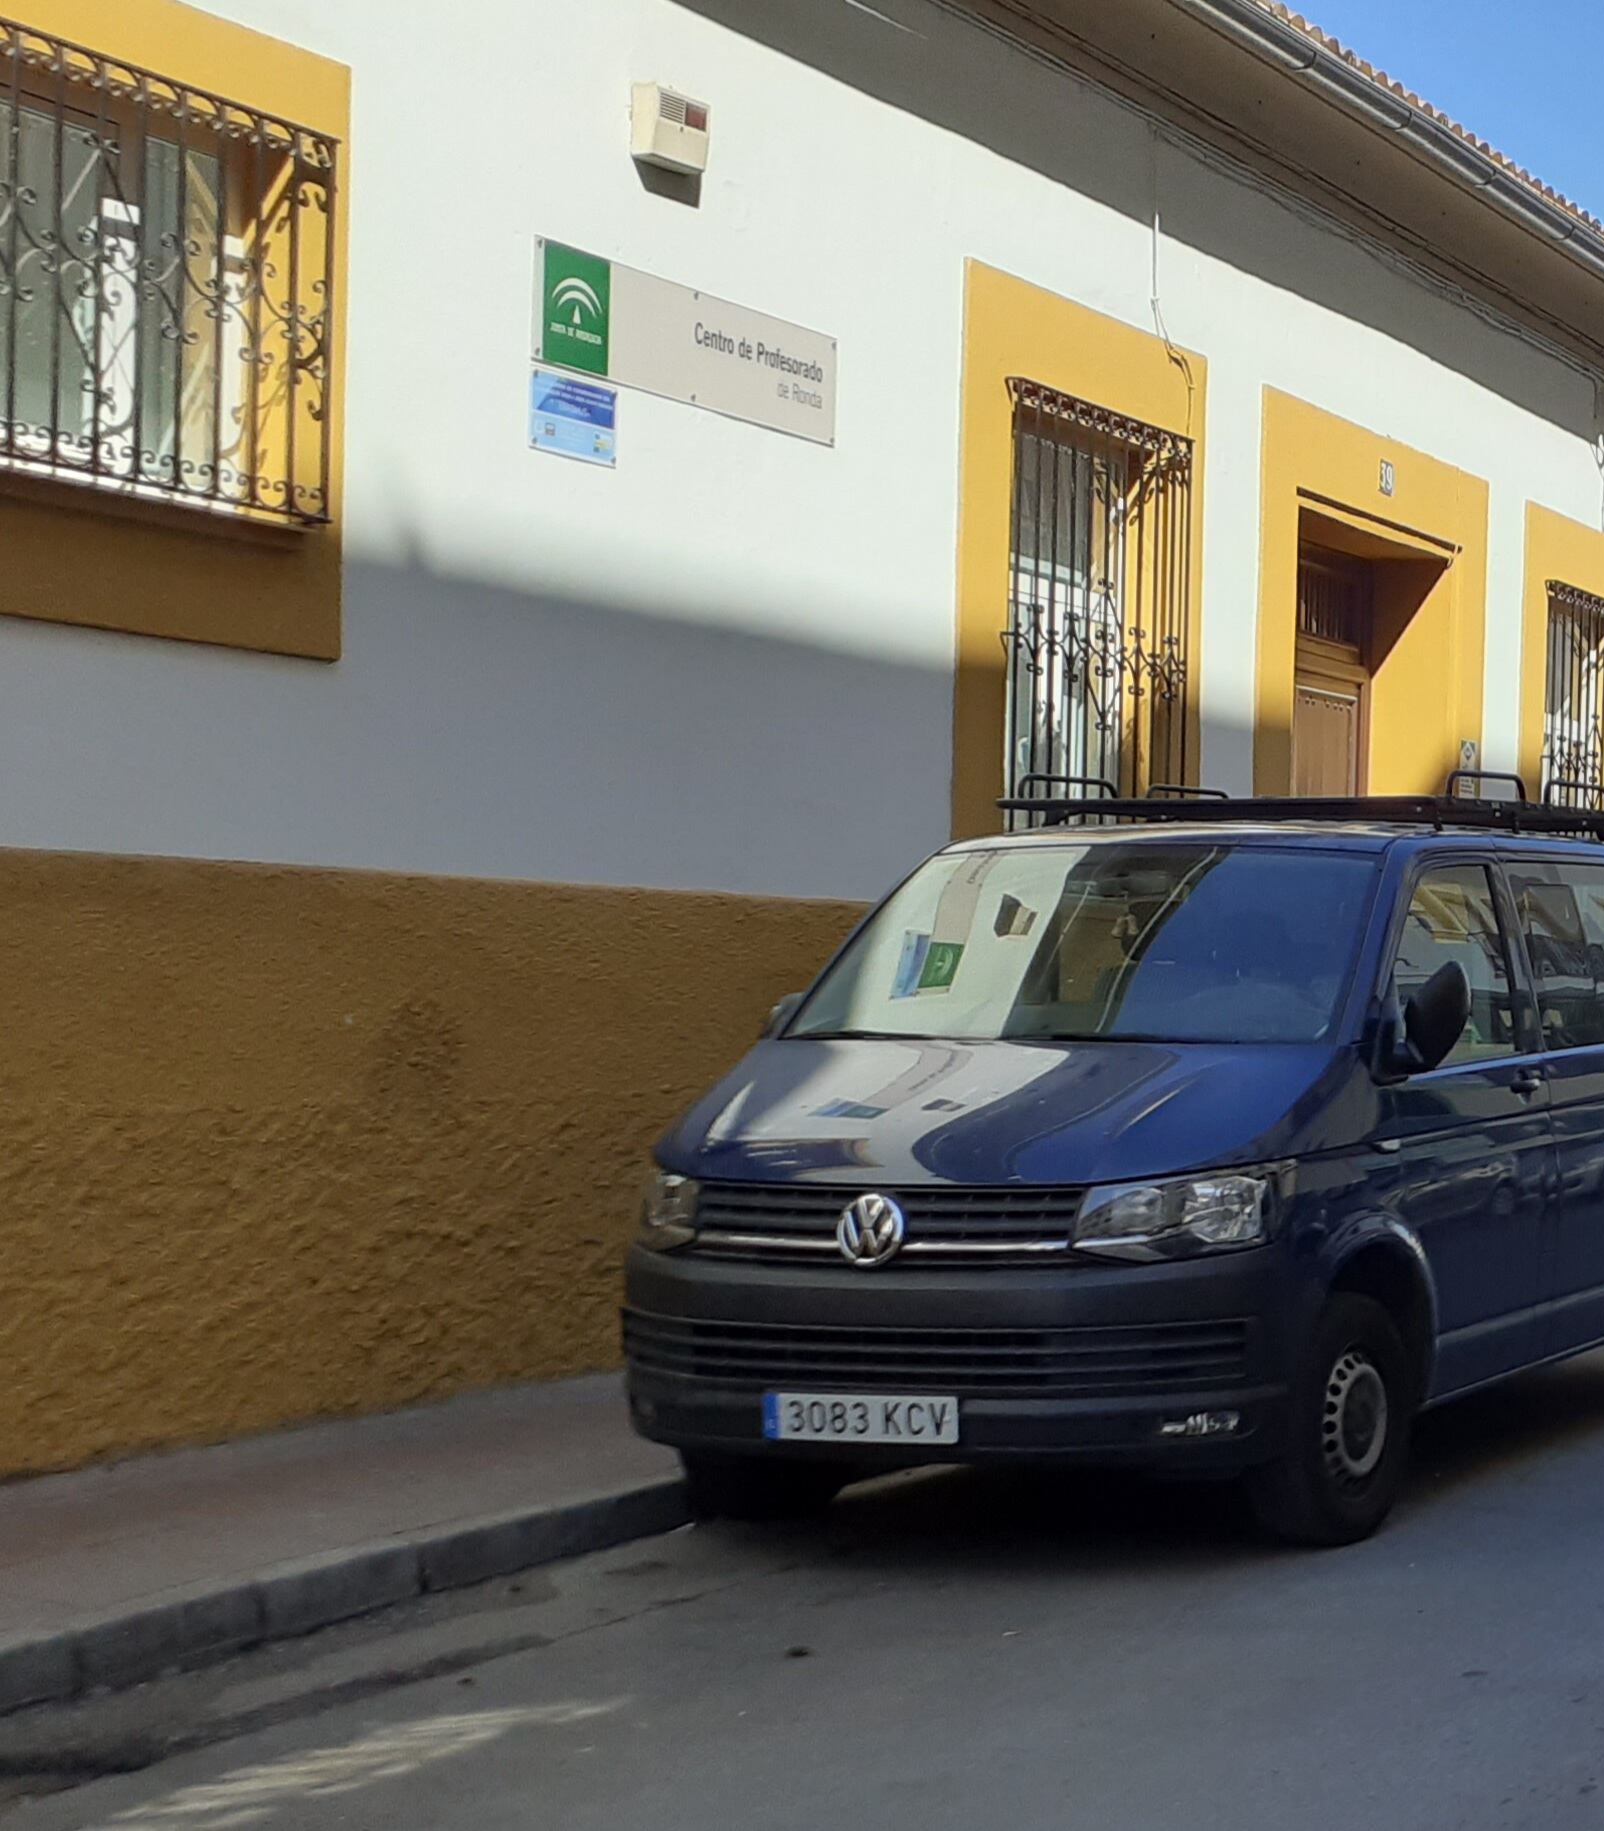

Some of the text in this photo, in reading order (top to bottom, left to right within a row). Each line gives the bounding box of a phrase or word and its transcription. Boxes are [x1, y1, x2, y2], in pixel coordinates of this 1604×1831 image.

[694, 322, 823, 383] Centro de Profesorado
[792, 382, 823, 410] Ronda
[788, 1401, 948, 1436] 3083 KCV
